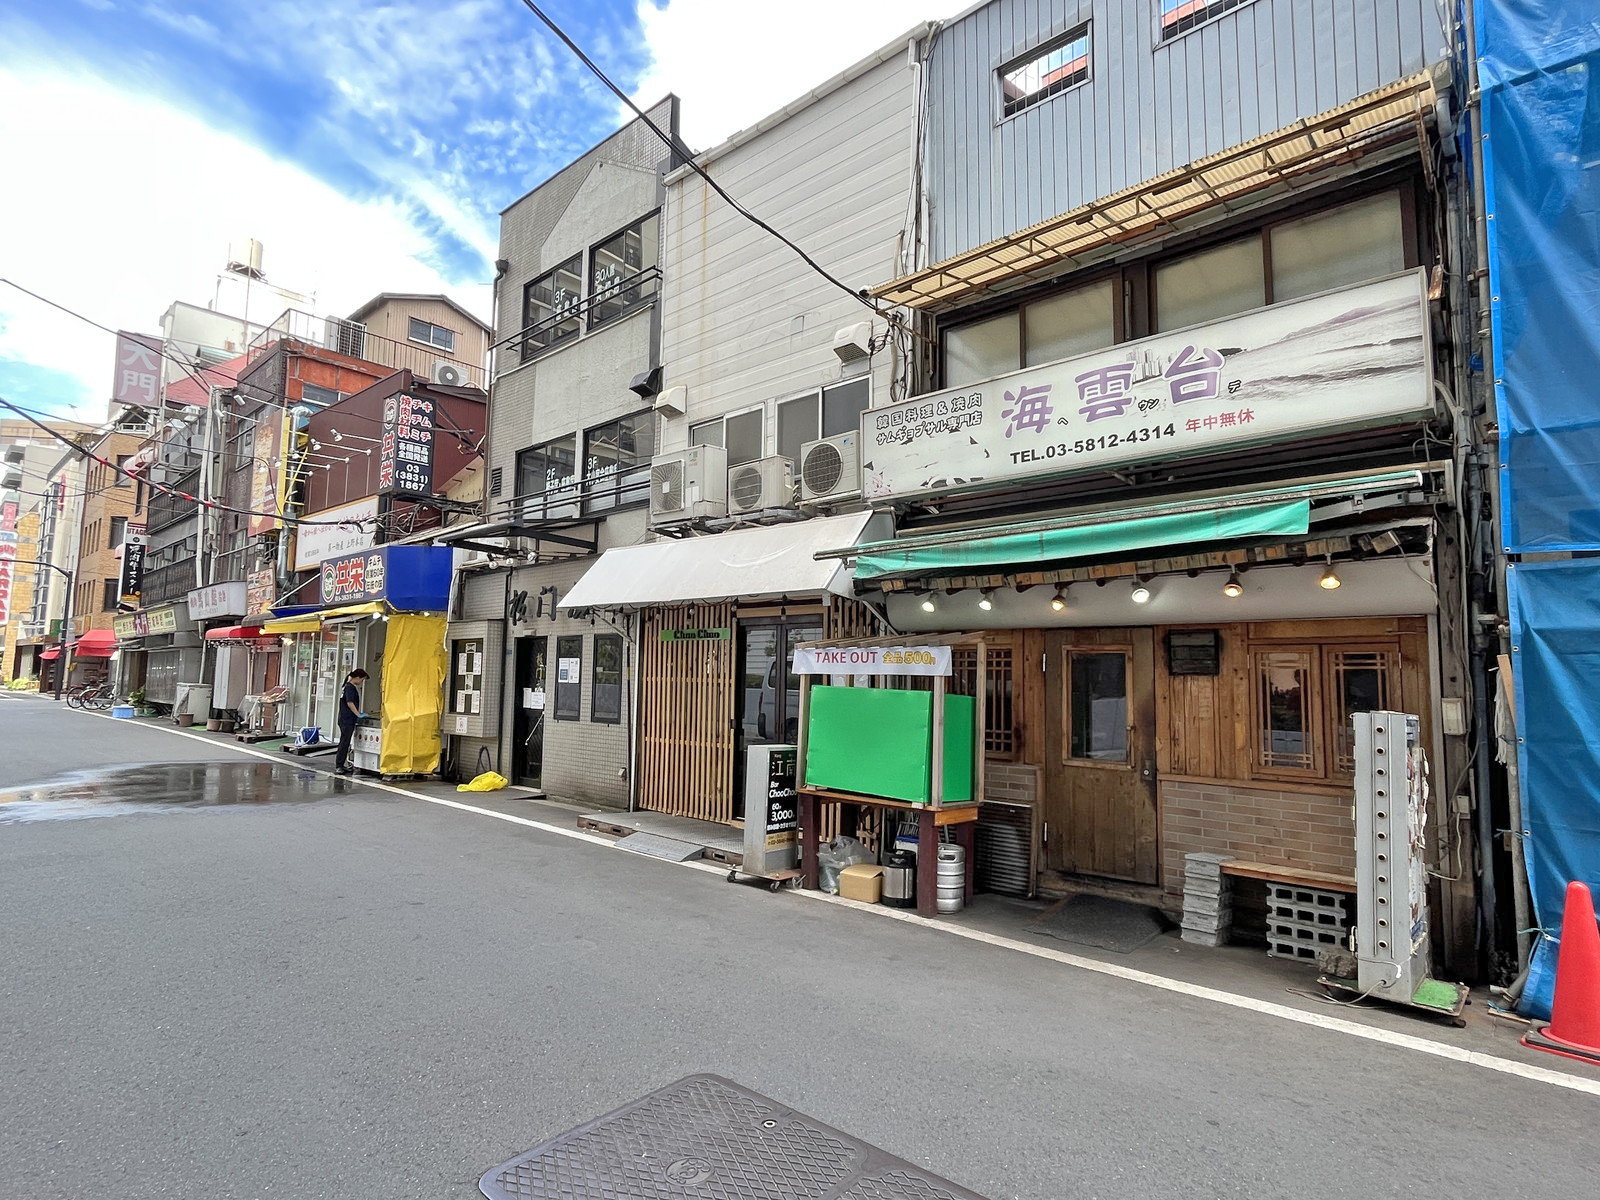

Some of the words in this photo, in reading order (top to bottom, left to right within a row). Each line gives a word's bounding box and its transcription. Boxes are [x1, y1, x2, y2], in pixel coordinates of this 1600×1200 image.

[554, 287, 566, 304] 3F
[120, 341, 159, 403] 大門
[1001, 345, 1224, 439] 海雲台
[1227, 379, 1242, 393] デ
[397, 394, 412, 440] 焼肉材料
[410, 398, 422, 441] チヂミ
[420, 401, 433, 443] キムチ
[1184, 408, 1255, 433] 年中無休
[875, 410, 983, 446] サムギョプサル専門店
[398, 442, 429, 456] 各種商品
[1010, 422, 1176, 465] TEL.03-5812-4314
[379, 430, 396, 490] 共栄
[397, 450, 429, 463] 全国発送
[587, 456, 598, 470] 3F
[395, 469, 428, 485] (3831)
[406, 464, 420, 474] 03
[546, 467, 556, 480] 2F
[399, 480, 425, 492] 1867
[368, 556, 381, 567] キムチ
[335, 556, 365, 596] 共栄
[135, 613, 149, 635] 大門
[814, 651, 847, 665] TAKE
[849, 651, 878, 664] OUT
